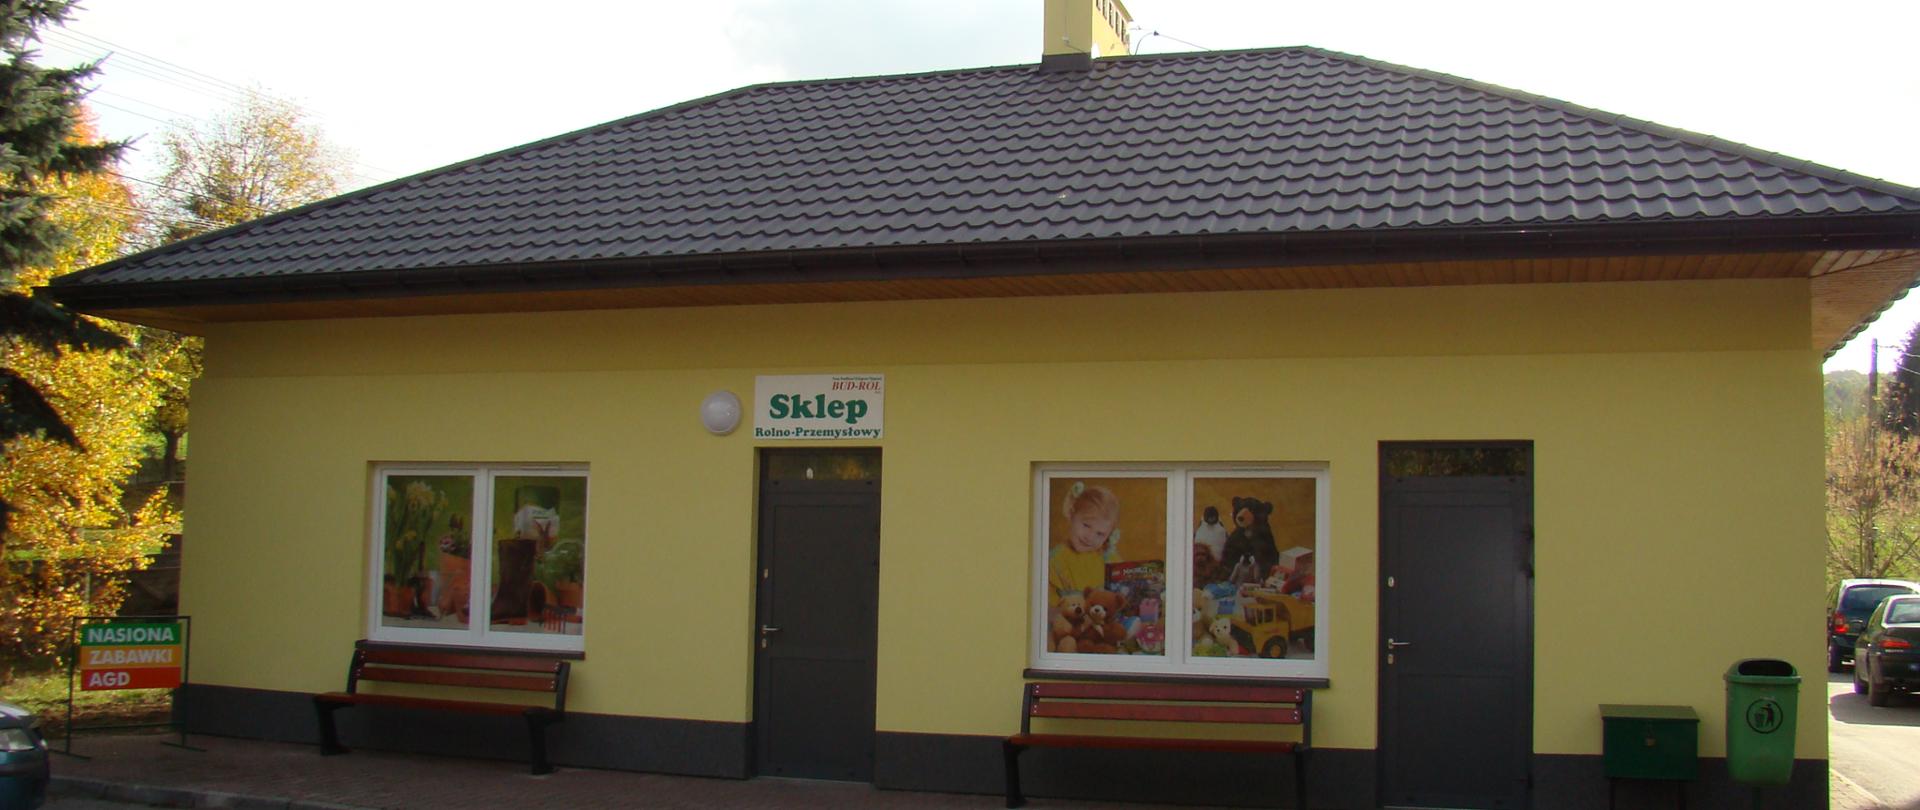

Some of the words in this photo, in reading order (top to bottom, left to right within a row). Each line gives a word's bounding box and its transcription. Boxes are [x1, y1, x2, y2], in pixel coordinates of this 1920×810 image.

[832, 381, 881, 391] BUD-ROL
[769, 394, 868, 424] Sklep
[755, 427, 881, 438] Rolno-Przemysłowy
[88, 628, 174, 642] NASIONA
[89, 649, 174, 665] ZABAWKI
[89, 672, 131, 687] AGD
